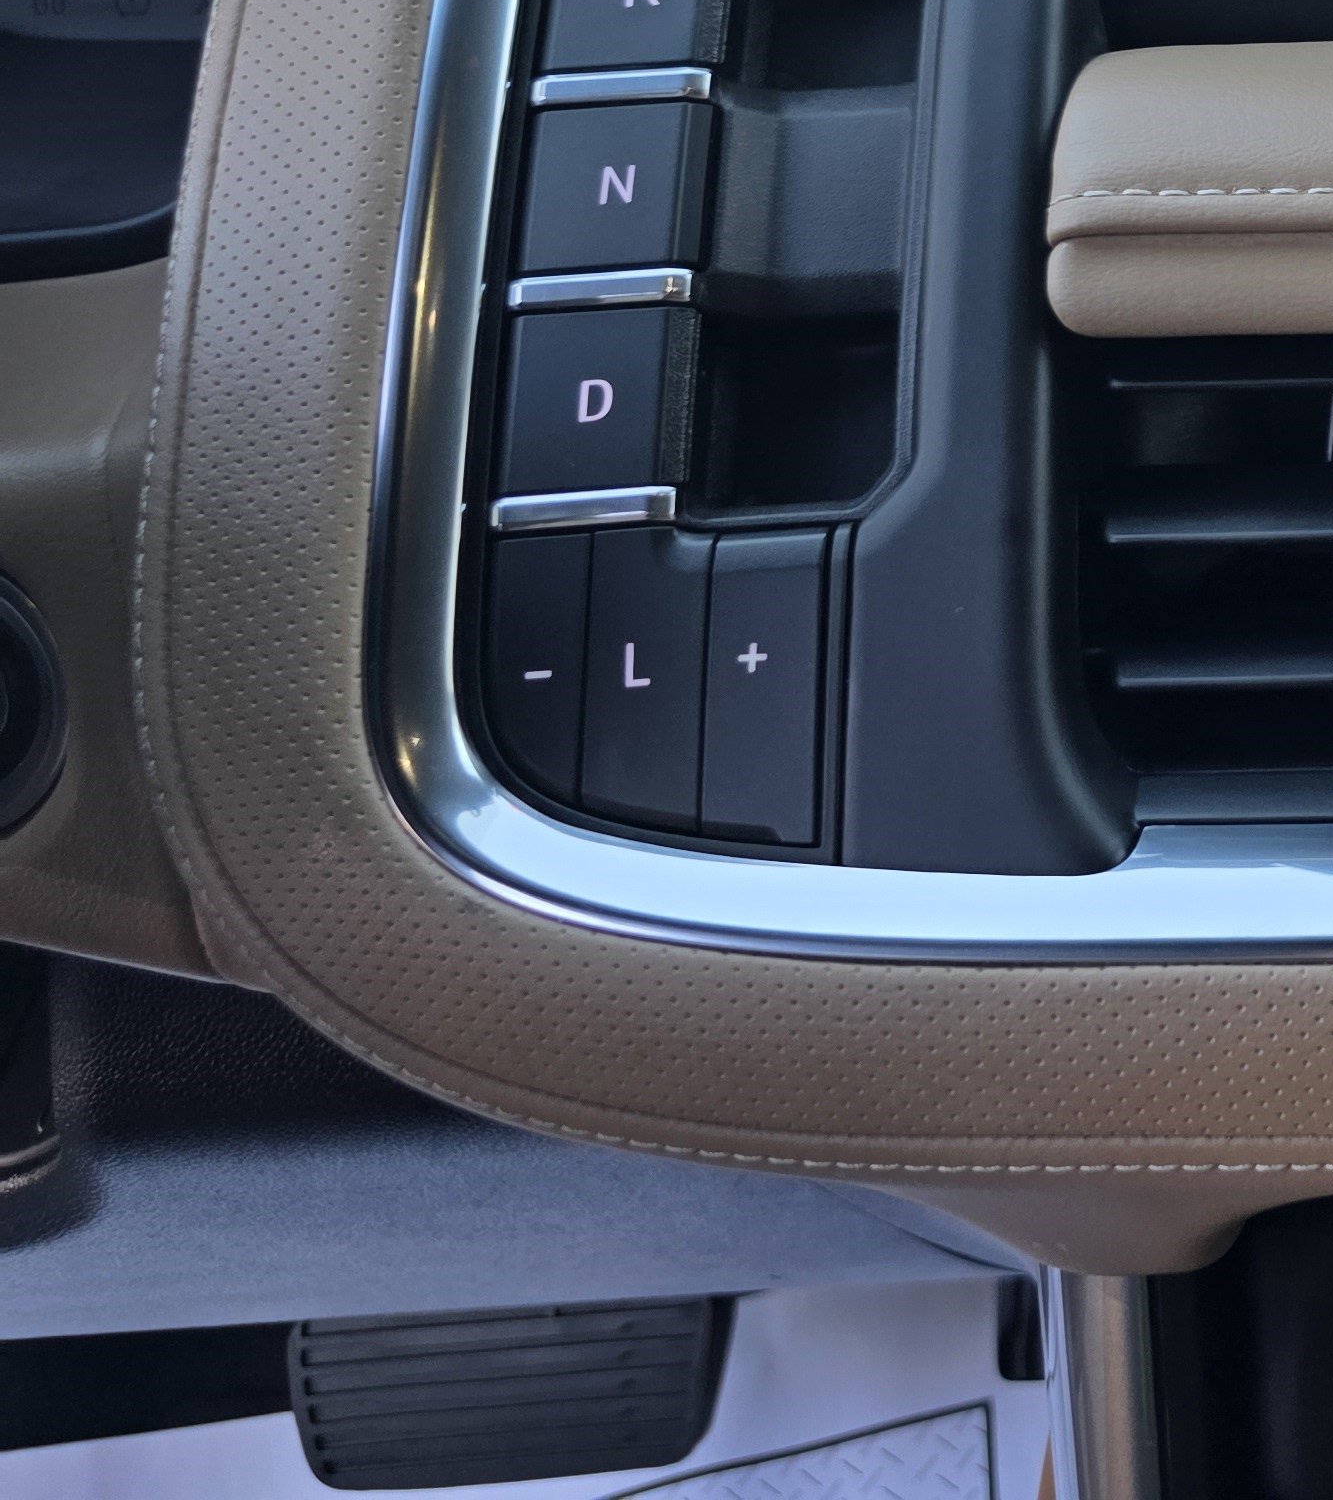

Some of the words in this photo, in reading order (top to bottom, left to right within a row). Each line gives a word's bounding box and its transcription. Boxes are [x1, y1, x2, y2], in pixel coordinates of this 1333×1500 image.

[598, 164, 636, 206] N
[577, 378, 614, 423] D
[623, 642, 651, 688] L
